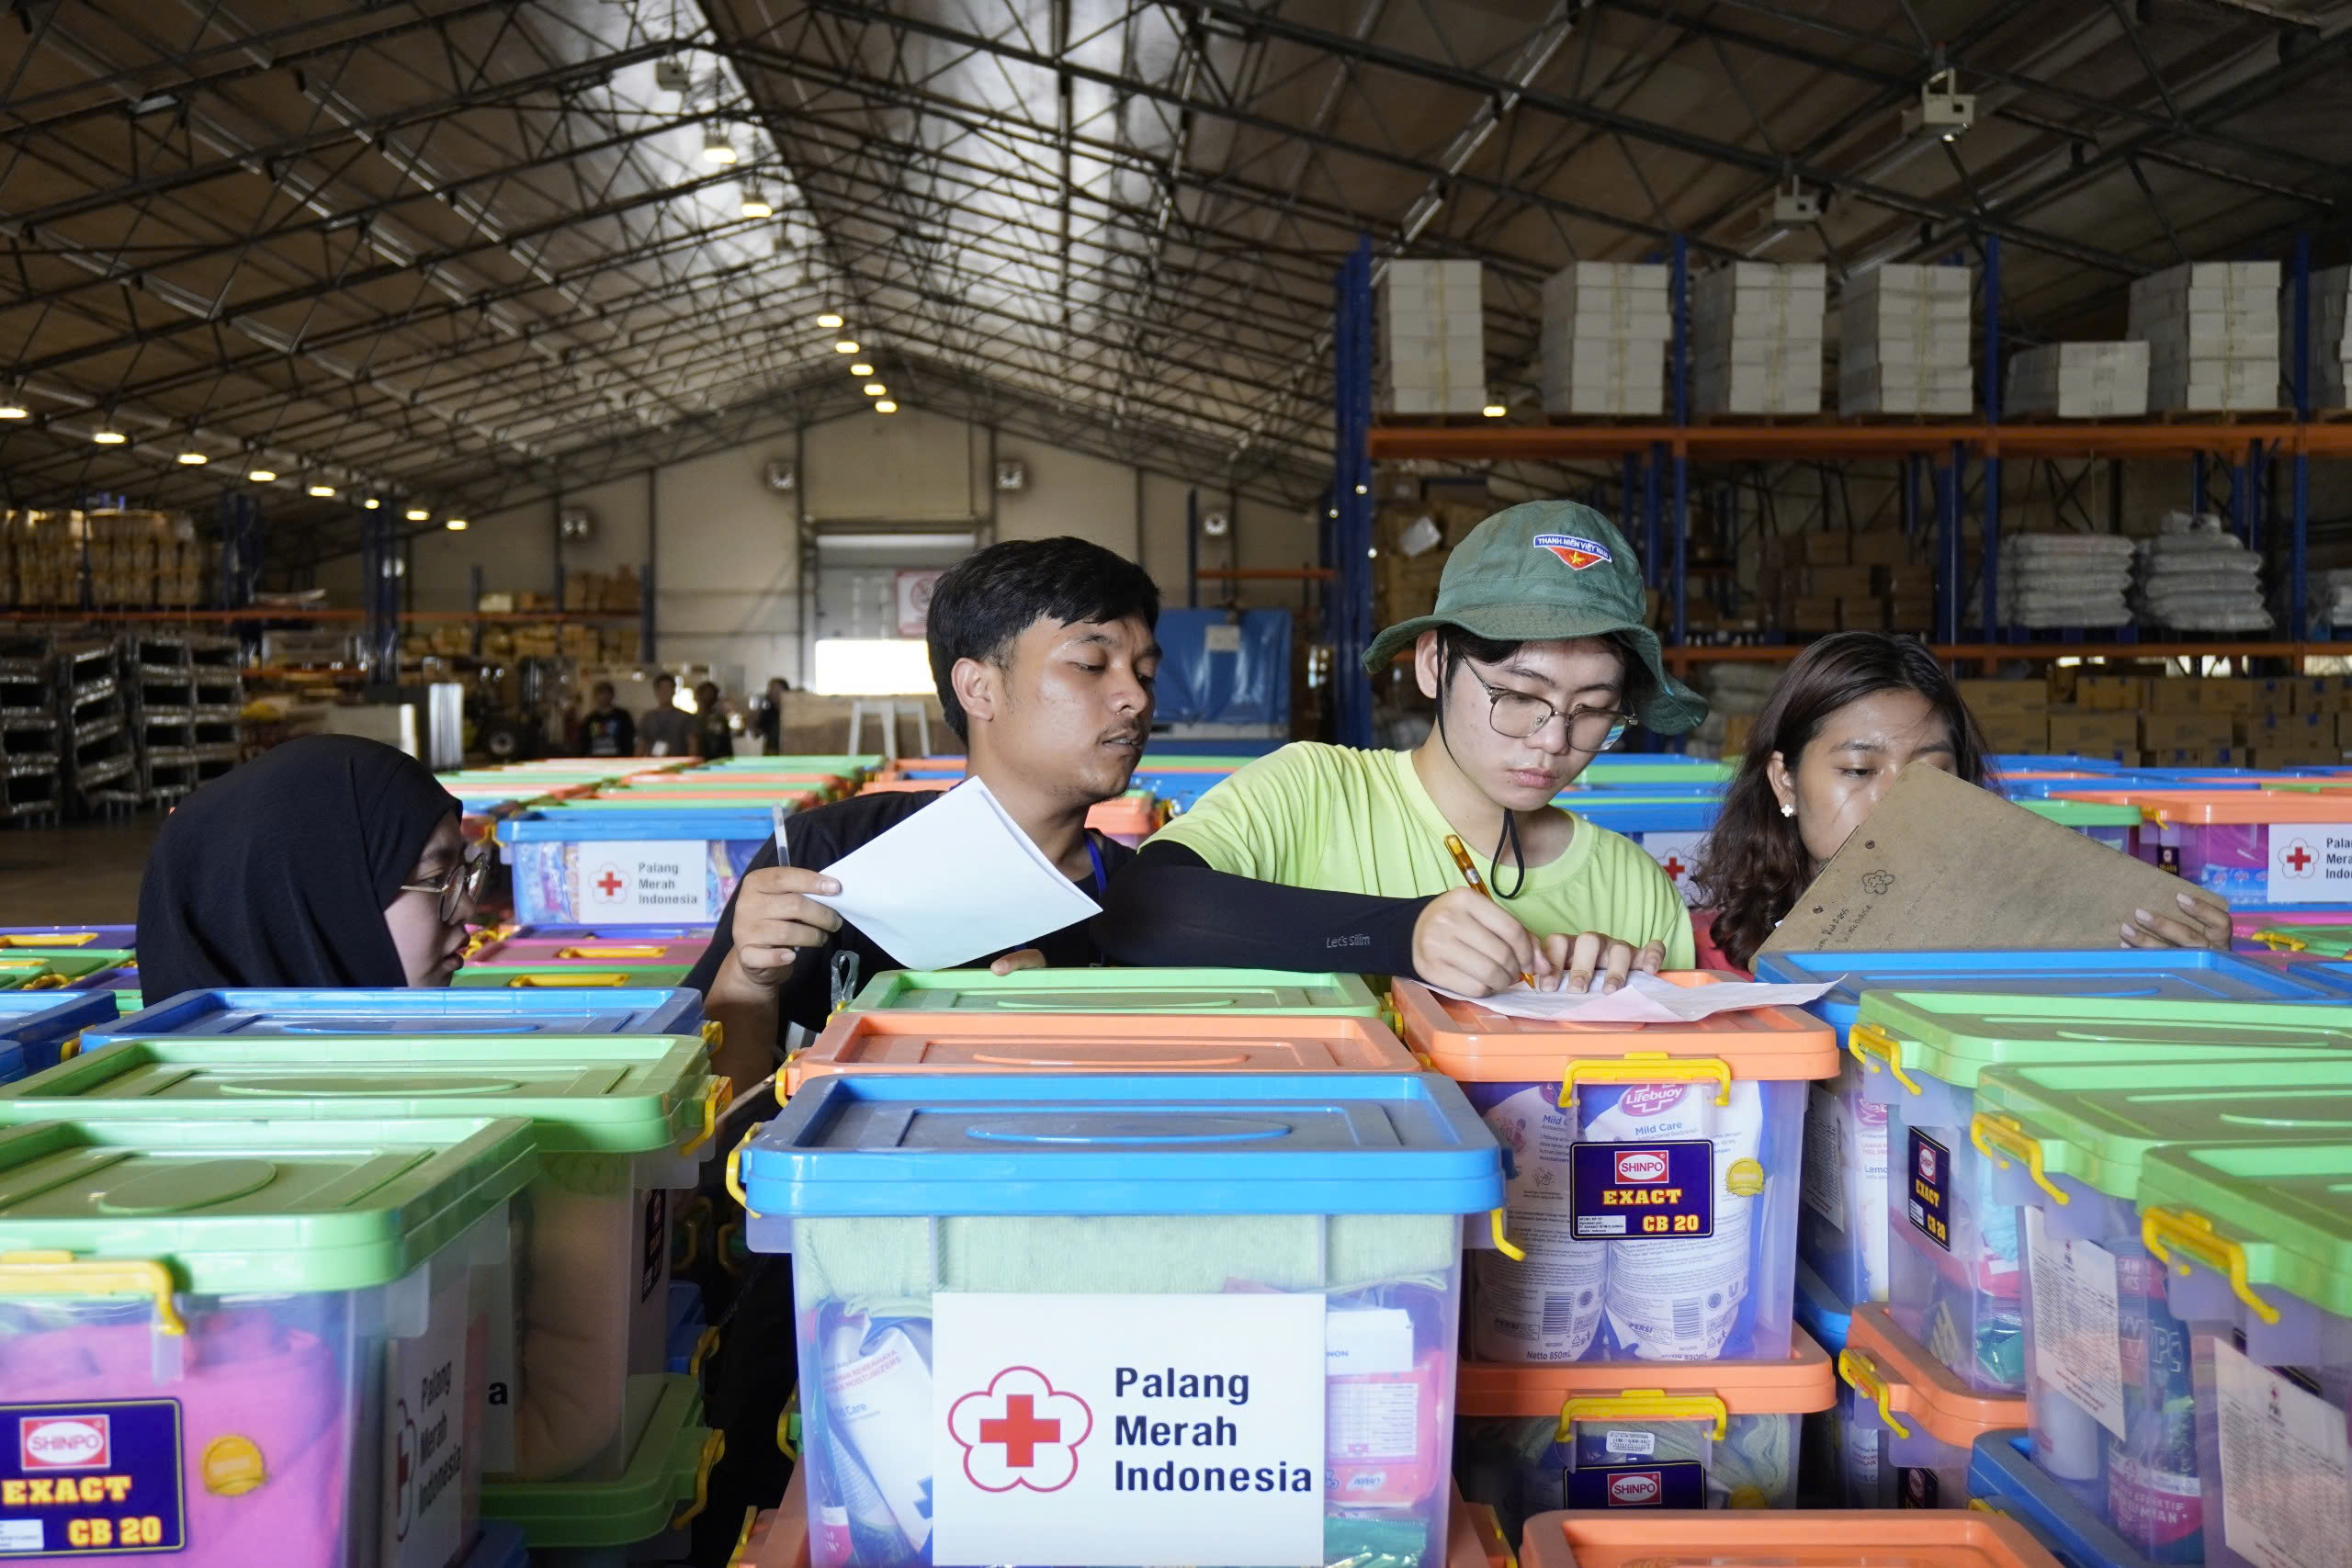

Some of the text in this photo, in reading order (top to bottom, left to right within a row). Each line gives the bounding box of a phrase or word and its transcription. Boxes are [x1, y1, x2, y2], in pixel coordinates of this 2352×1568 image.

[2326, 837, 2352, 849] Pala
[638, 862, 679, 875] Palang
[2326, 868, 2352, 879] Indo
[638, 879, 675, 890] Merah
[638, 894, 698, 905] Indonesia
[1625, 1087, 1684, 1105] Lifebuoy
[1543, 1114, 1563, 1125] Mild
[1634, 1122, 1683, 1135] Mild Care
[1621, 1161, 1664, 1173] SHINPO
[1602, 1188, 1682, 1206] EXACT
[1916, 1179, 1940, 1208] EXACT
[1642, 1214, 1700, 1233] CB 20
[1927, 1213, 1937, 1235] CB
[1937, 1223, 1946, 1242] 20
[1526, 1350, 1548, 1360] Netto
[1115, 1367, 1250, 1405] Palang
[1115, 1415, 1238, 1447] Merah
[30, 1434, 100, 1451] SHINPO
[1115, 1460, 1313, 1493] Indonesia
[2, 1475, 133, 1506] EXACT
[1613, 1483, 1657, 1495] SHINPO
[67, 1517, 113, 1548] CB
[119, 1516, 163, 1546] 20
